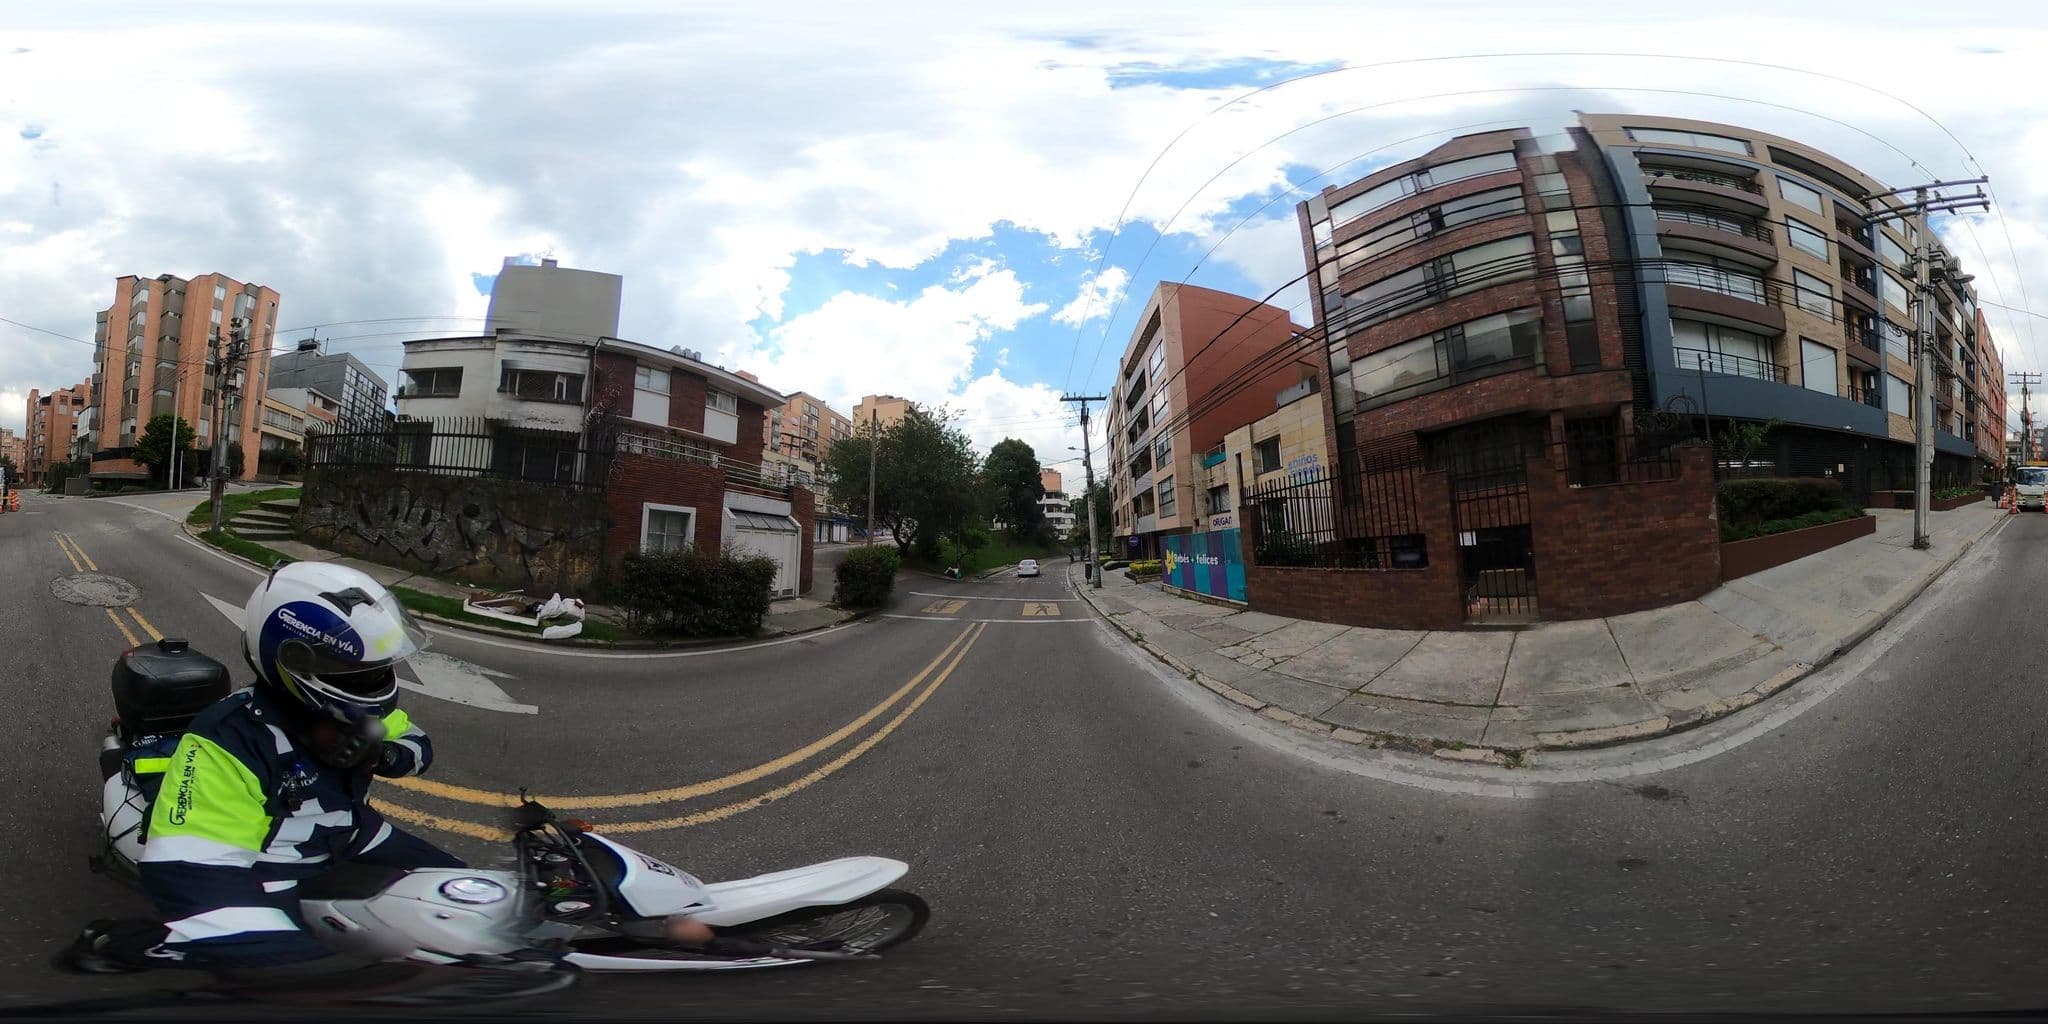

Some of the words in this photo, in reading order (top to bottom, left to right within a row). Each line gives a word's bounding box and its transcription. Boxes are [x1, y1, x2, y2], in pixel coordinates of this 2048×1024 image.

[1196, 553, 1219, 565] felices
[278, 608, 321, 640] GERENCIA
[322, 633, 337, 646] EN
[339, 640, 354, 654] VÍA
[186, 749, 197, 764] VÍA
[183, 765, 192, 778] EN
[169, 779, 189, 826] GERENCIA
